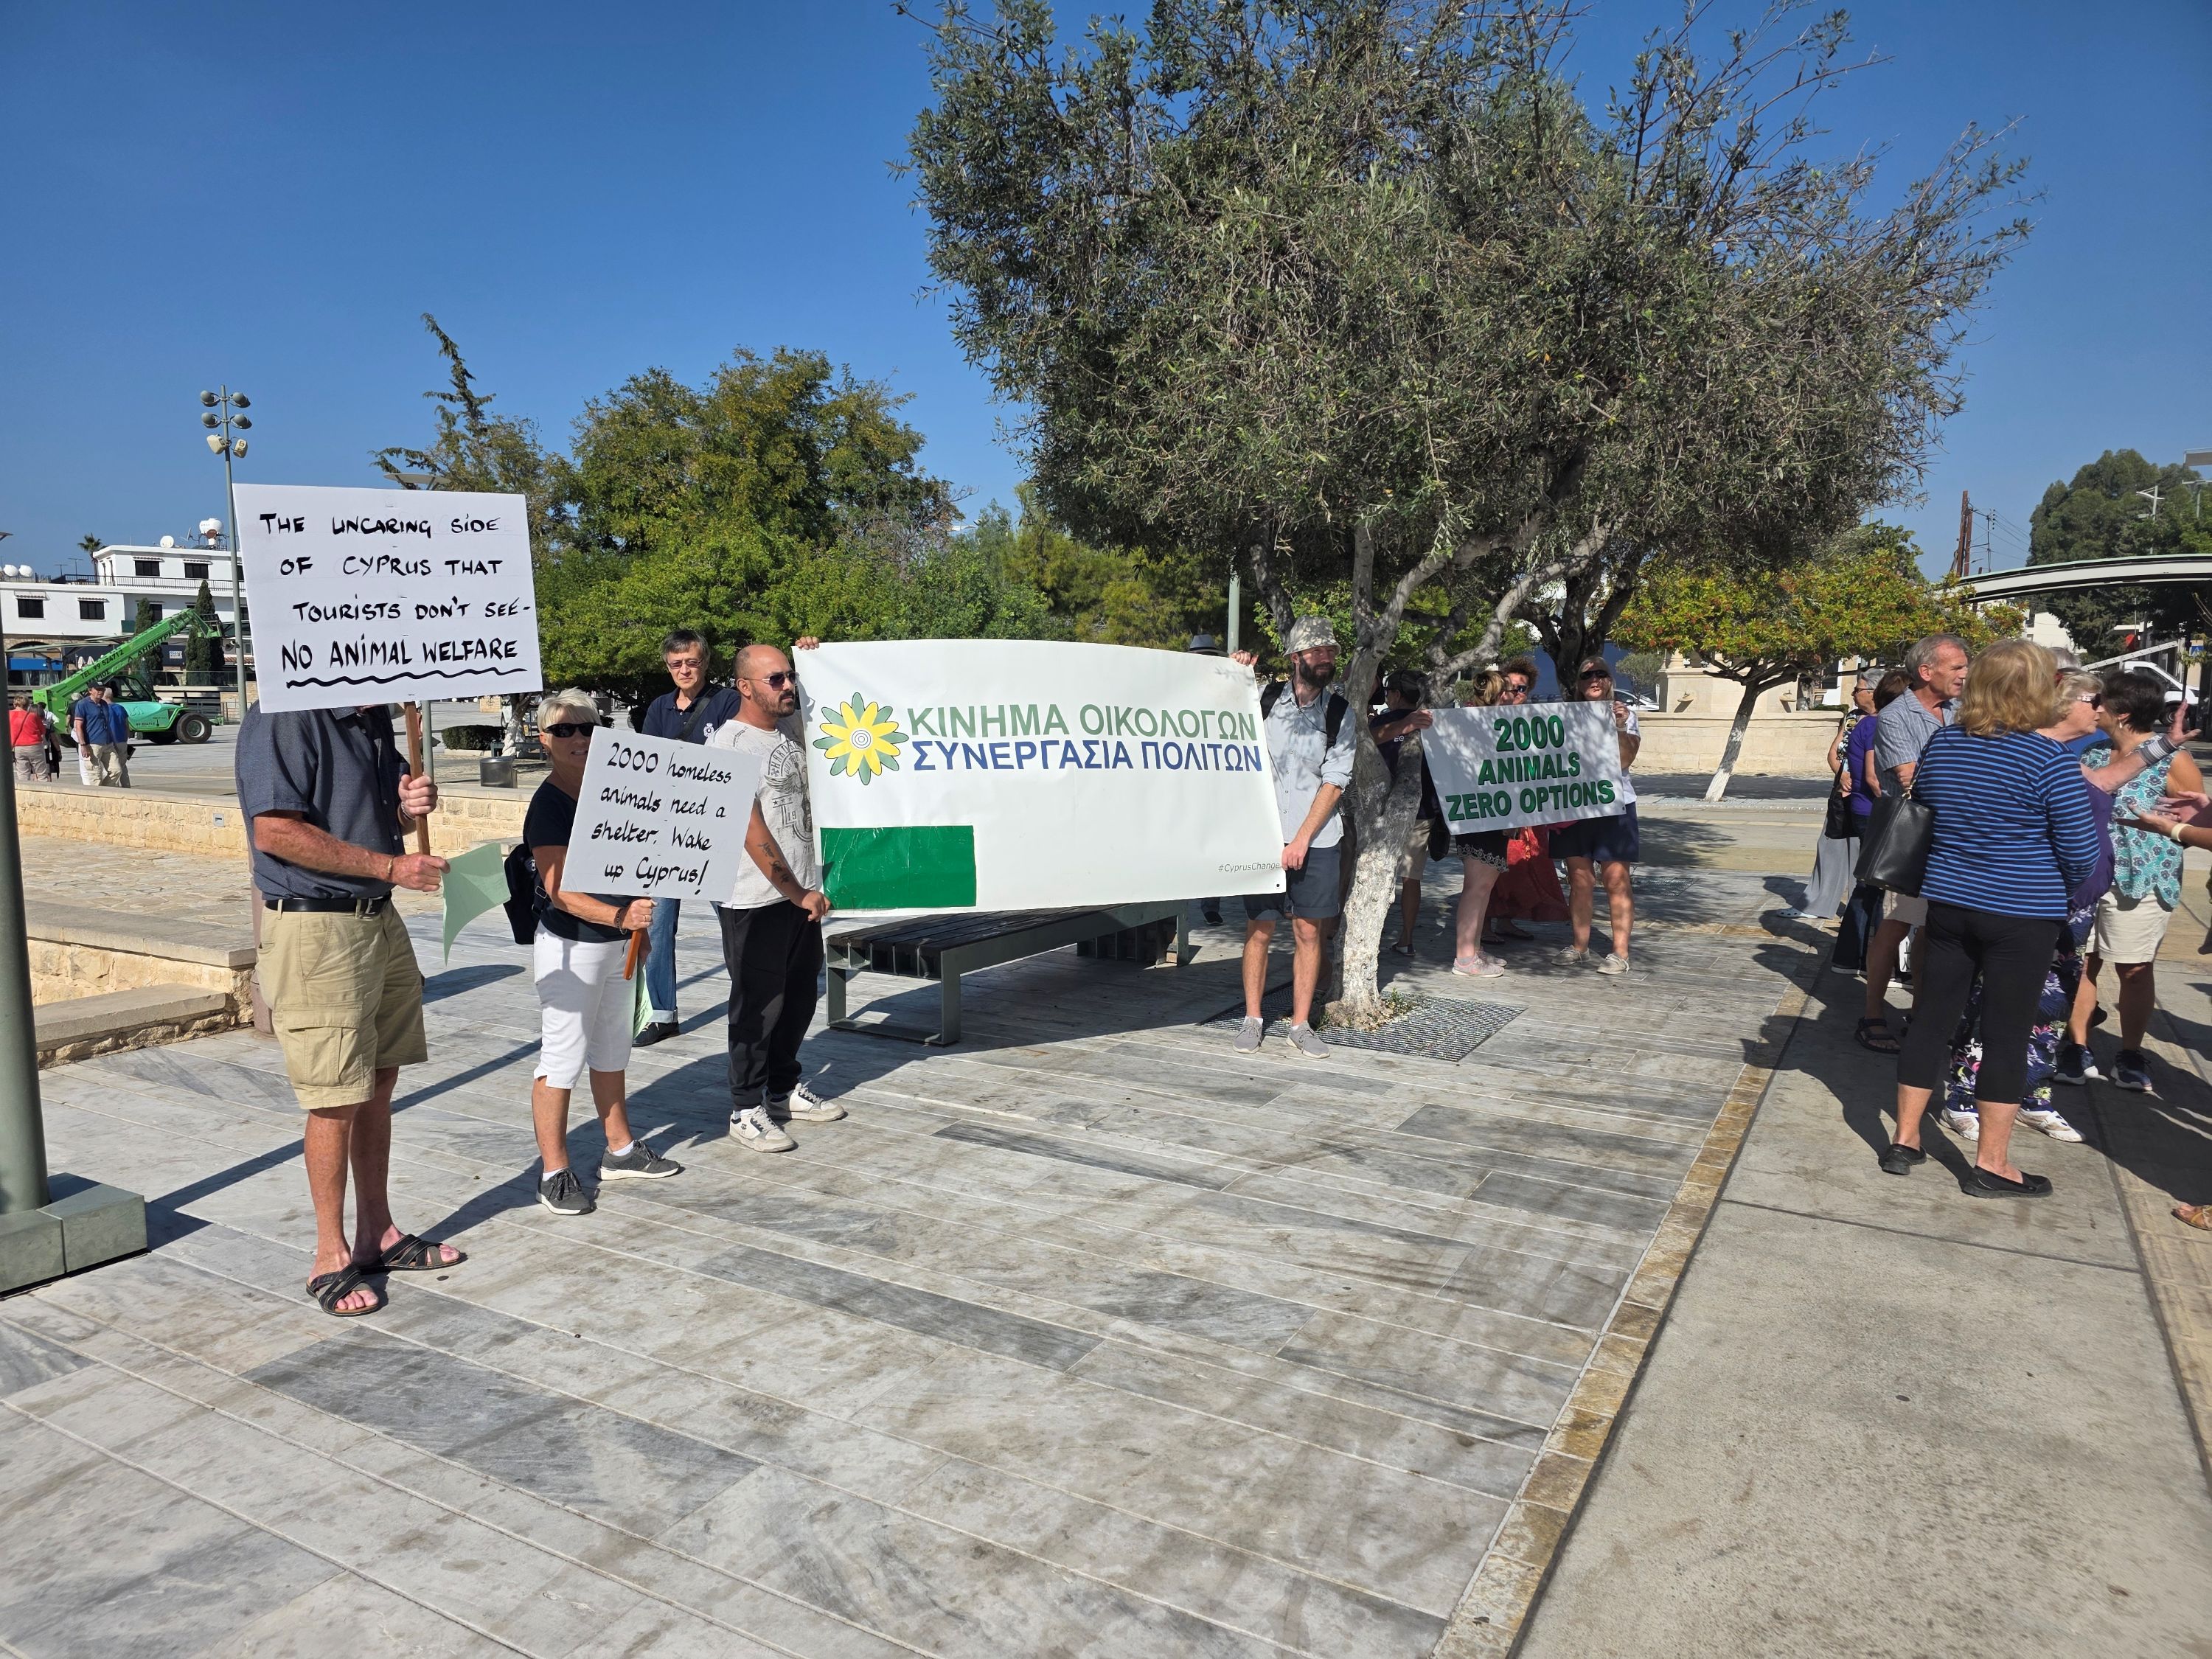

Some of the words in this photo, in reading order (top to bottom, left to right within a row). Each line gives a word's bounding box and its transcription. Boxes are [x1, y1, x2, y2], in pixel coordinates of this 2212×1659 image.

[259, 512, 305, 535] THE
[332, 516, 431, 539] UNCARING
[280, 556, 313, 577] OF
[342, 554, 433, 577] CYPRUS
[444, 559, 504, 577] THAT
[414, 595, 471, 621] DON'T
[93, 663, 101, 672] 99
[281, 640, 313, 672] NO
[422, 637, 518, 664] WELFARE
[906, 703, 1070, 739] ΚΙΝΗΜΑ
[1079, 703, 1257, 742] ΟΙΚΟΛΟΓΩΝ
[1493, 714, 1565, 752] 2000
[607, 742, 658, 773] 2000
[666, 752, 732, 785] homeless
[911, 740, 1135, 771] ΣΥΝΕΡΓΑΣΙΑ
[1141, 741, 1263, 773] ΠΟΛΙΤΩΝ
[1477, 751, 1581, 786] ANIMALS
[600, 785, 662, 813] animals
[669, 796, 708, 816] need
[715, 805, 727, 818] a
[1445, 790, 1512, 821] ZERO
[1519, 779, 1616, 814] OPTIONS
[671, 824, 713, 851] Wake
[604, 863, 625, 883] up
[635, 856, 709, 895] Cyprus!
